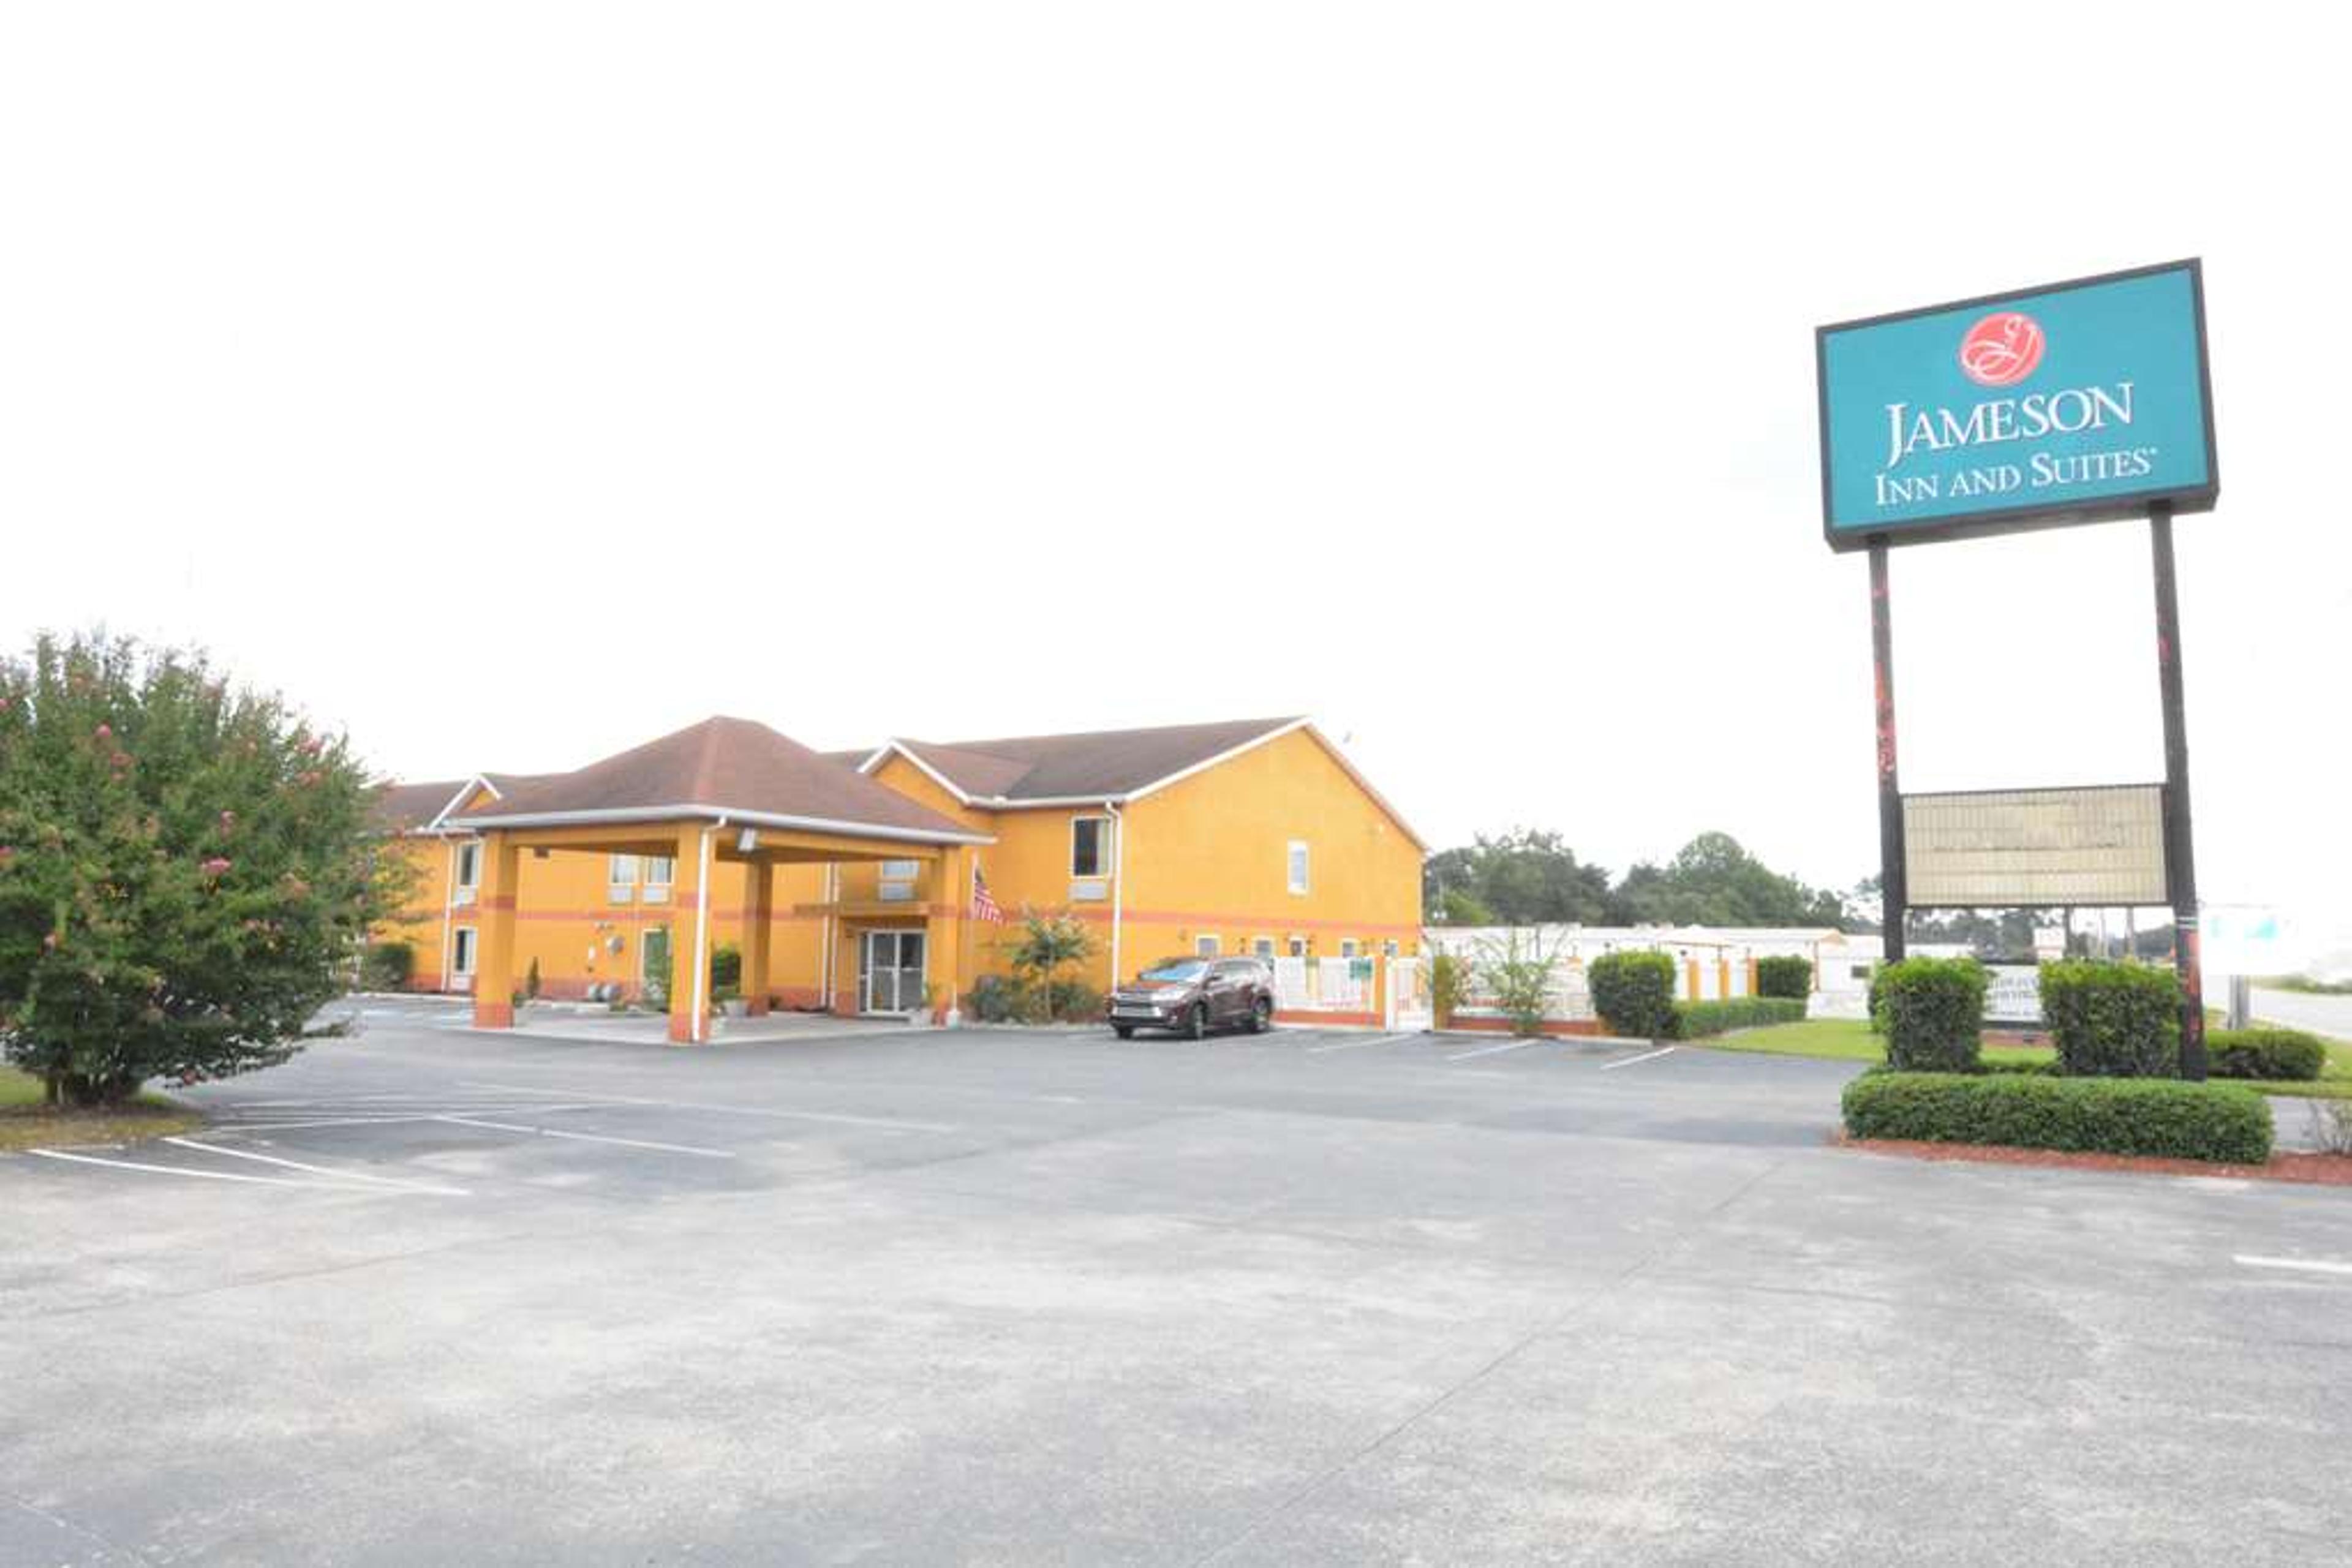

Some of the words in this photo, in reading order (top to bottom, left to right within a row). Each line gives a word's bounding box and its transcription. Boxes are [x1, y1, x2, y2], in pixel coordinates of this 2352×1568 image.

[1886, 382, 2135, 467] JAMESON
[1875, 473, 1939, 505] INN
[1949, 465, 2021, 497] AND
[2031, 448, 2154, 487] SUITES
